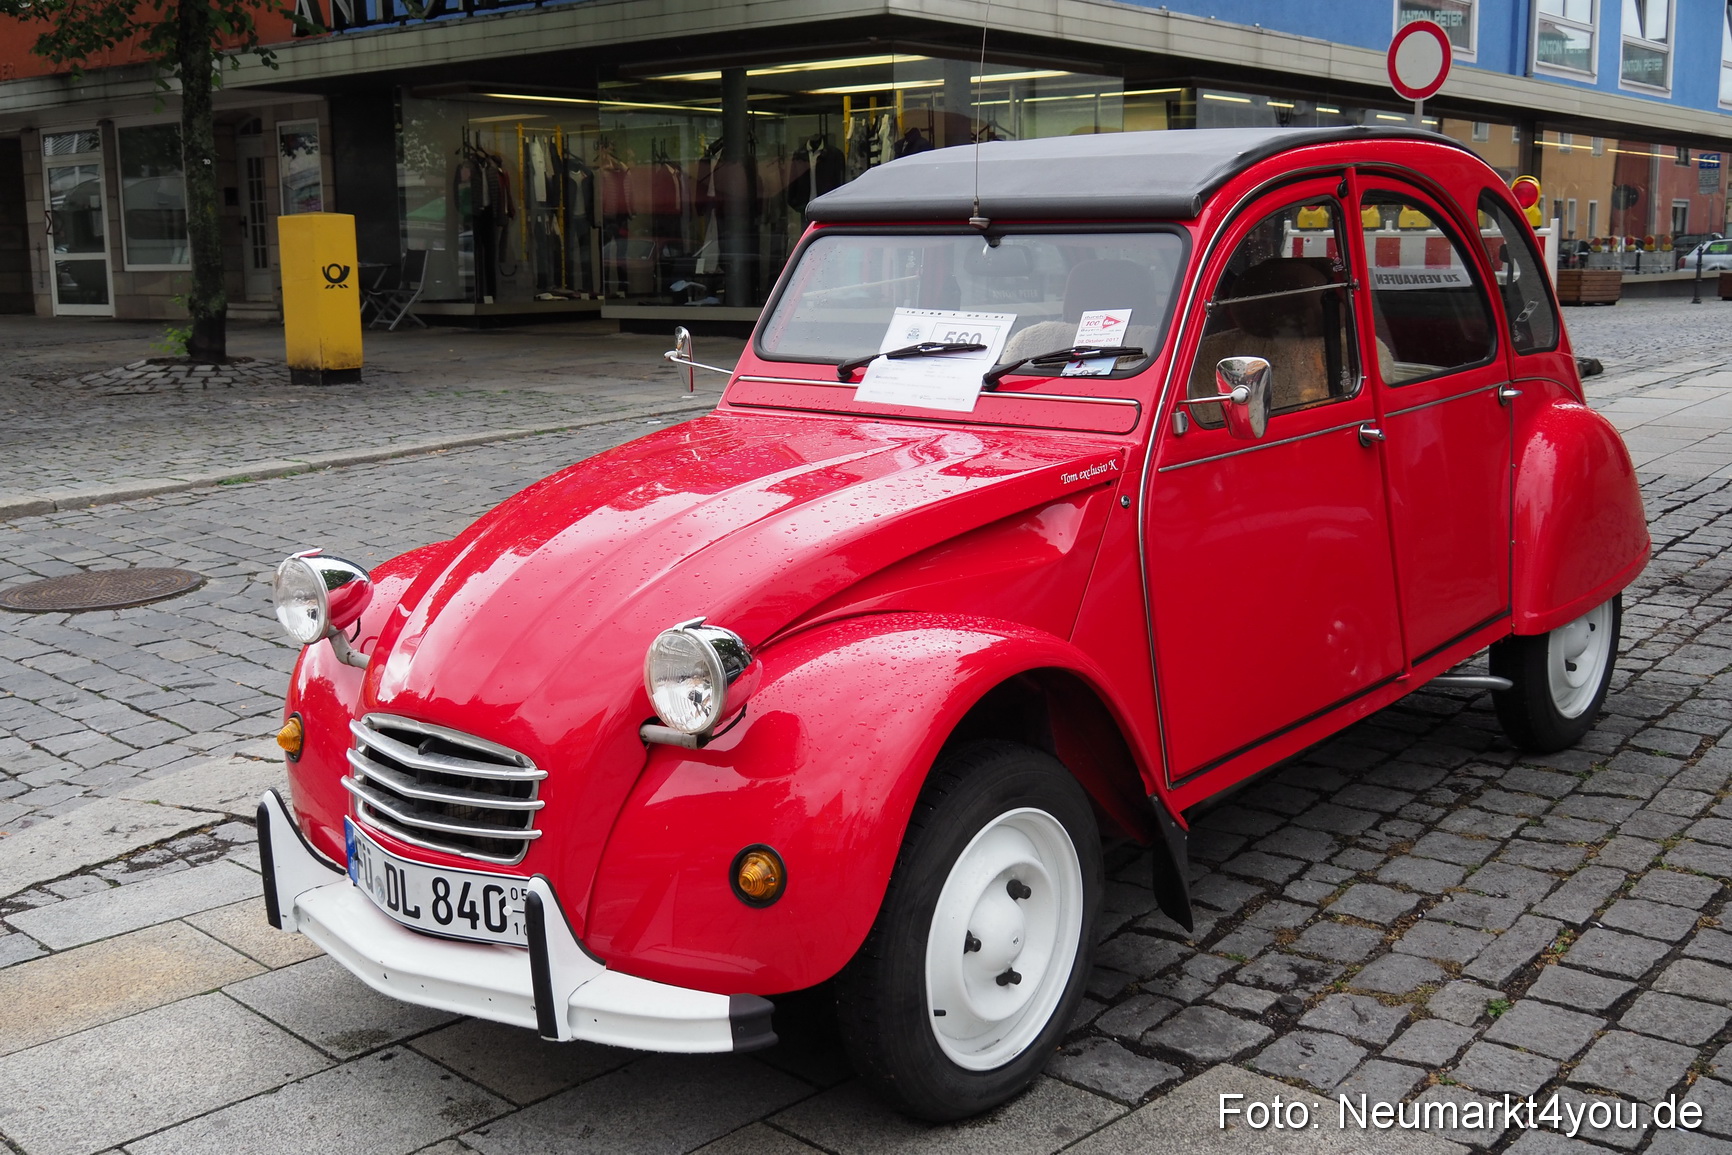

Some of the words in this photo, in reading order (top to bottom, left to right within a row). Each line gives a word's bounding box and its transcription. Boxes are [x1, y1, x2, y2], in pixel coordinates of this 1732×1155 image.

[1401, 10, 1431, 26] ANTON
[1434, 10, 1463, 26] PETER
[943, 330, 982, 344] 560
[1060, 472, 1078, 485] Tom
[1079, 463, 1108, 480] exclusiv
[1108, 458, 1119, 471] K
[354, 834, 375, 895] FÜ
[384, 860, 421, 919] DL
[431, 876, 508, 934] 840
